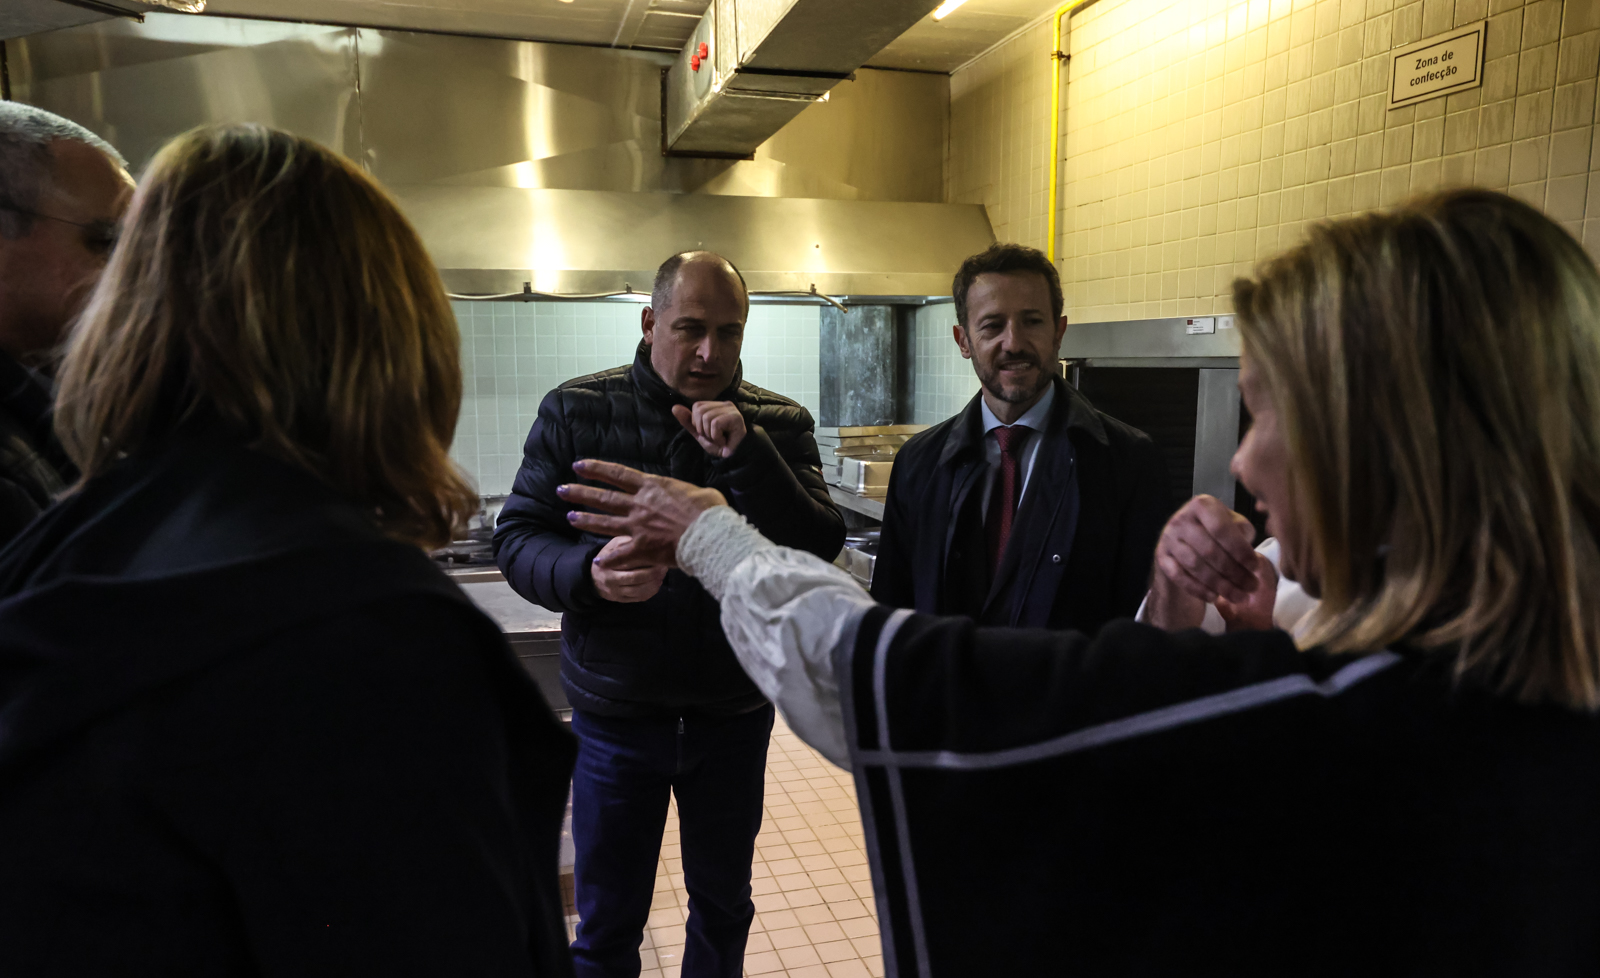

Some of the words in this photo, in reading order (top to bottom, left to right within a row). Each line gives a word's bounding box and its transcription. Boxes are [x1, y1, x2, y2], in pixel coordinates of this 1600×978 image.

[1415, 56, 1438, 70] Zona
[1441, 50, 1454, 62] de
[1410, 66, 1458, 87] confecção
